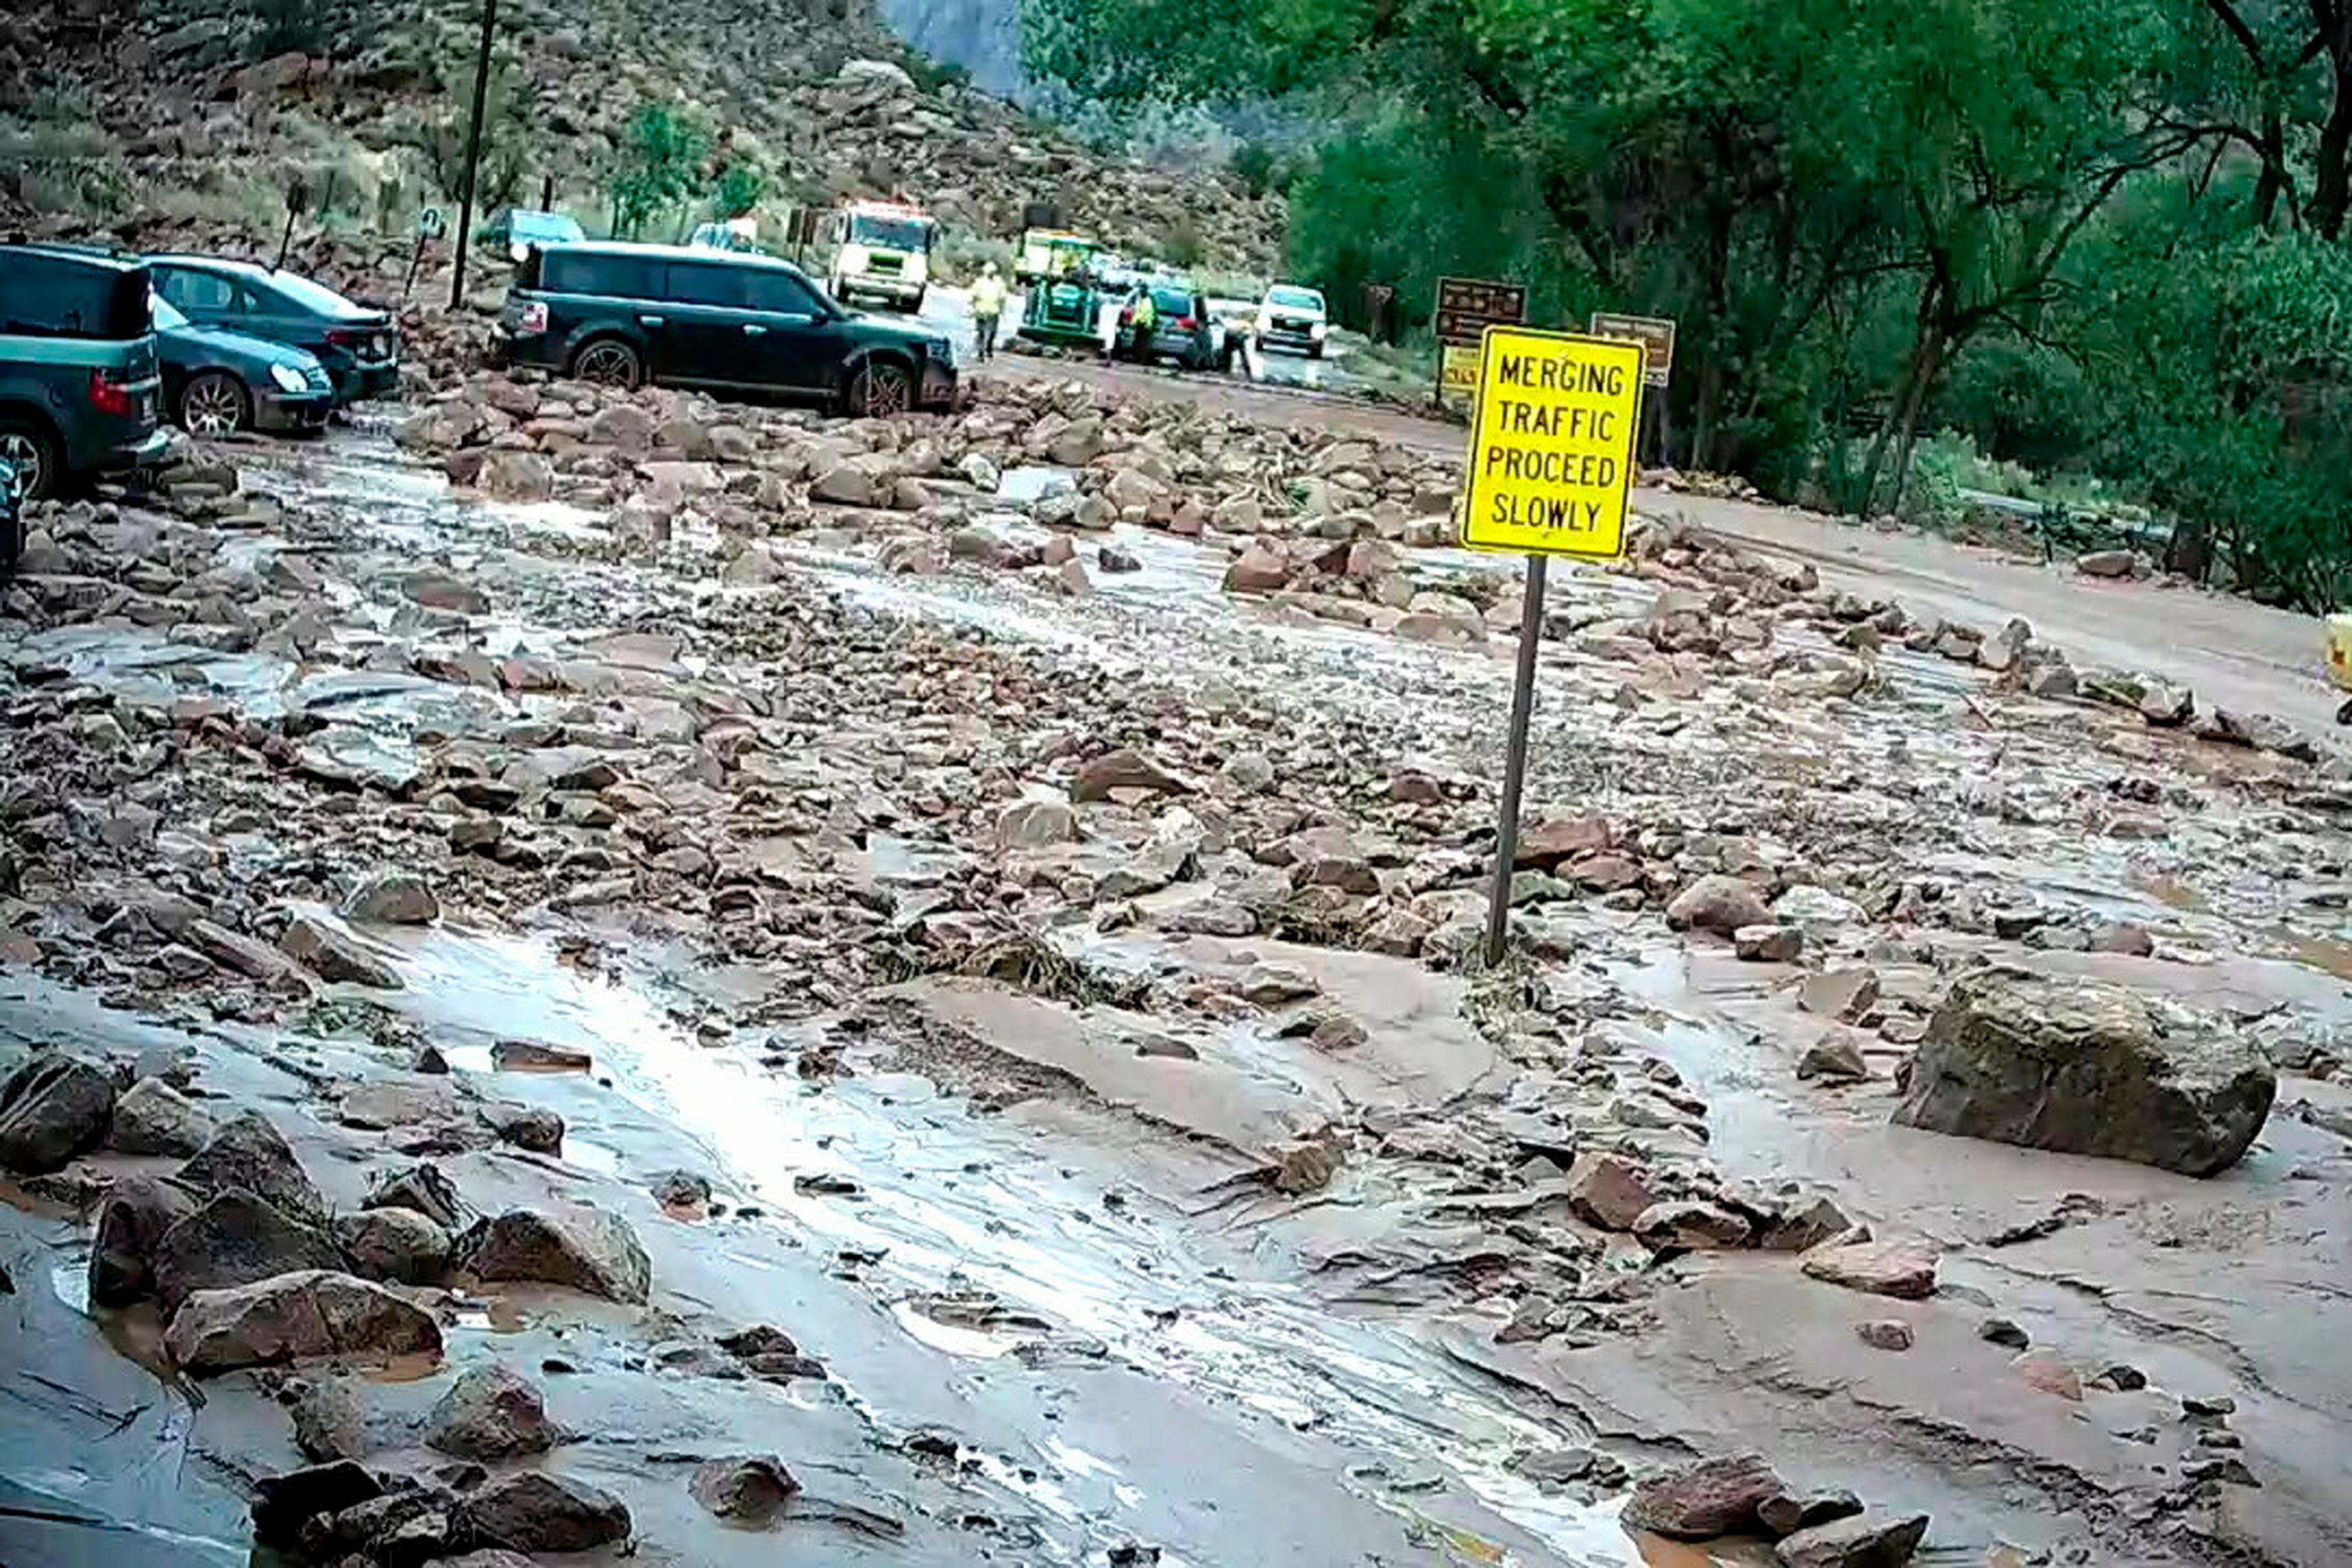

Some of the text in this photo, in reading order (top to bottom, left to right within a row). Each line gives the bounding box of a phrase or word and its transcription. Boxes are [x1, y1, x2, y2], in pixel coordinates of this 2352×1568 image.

[1500, 354, 1624, 395] MERGING
[1498, 401, 1615, 441] TRAFFIC
[1486, 446, 1615, 487] PROCEED
[1492, 493, 1602, 531] SLOWLY
